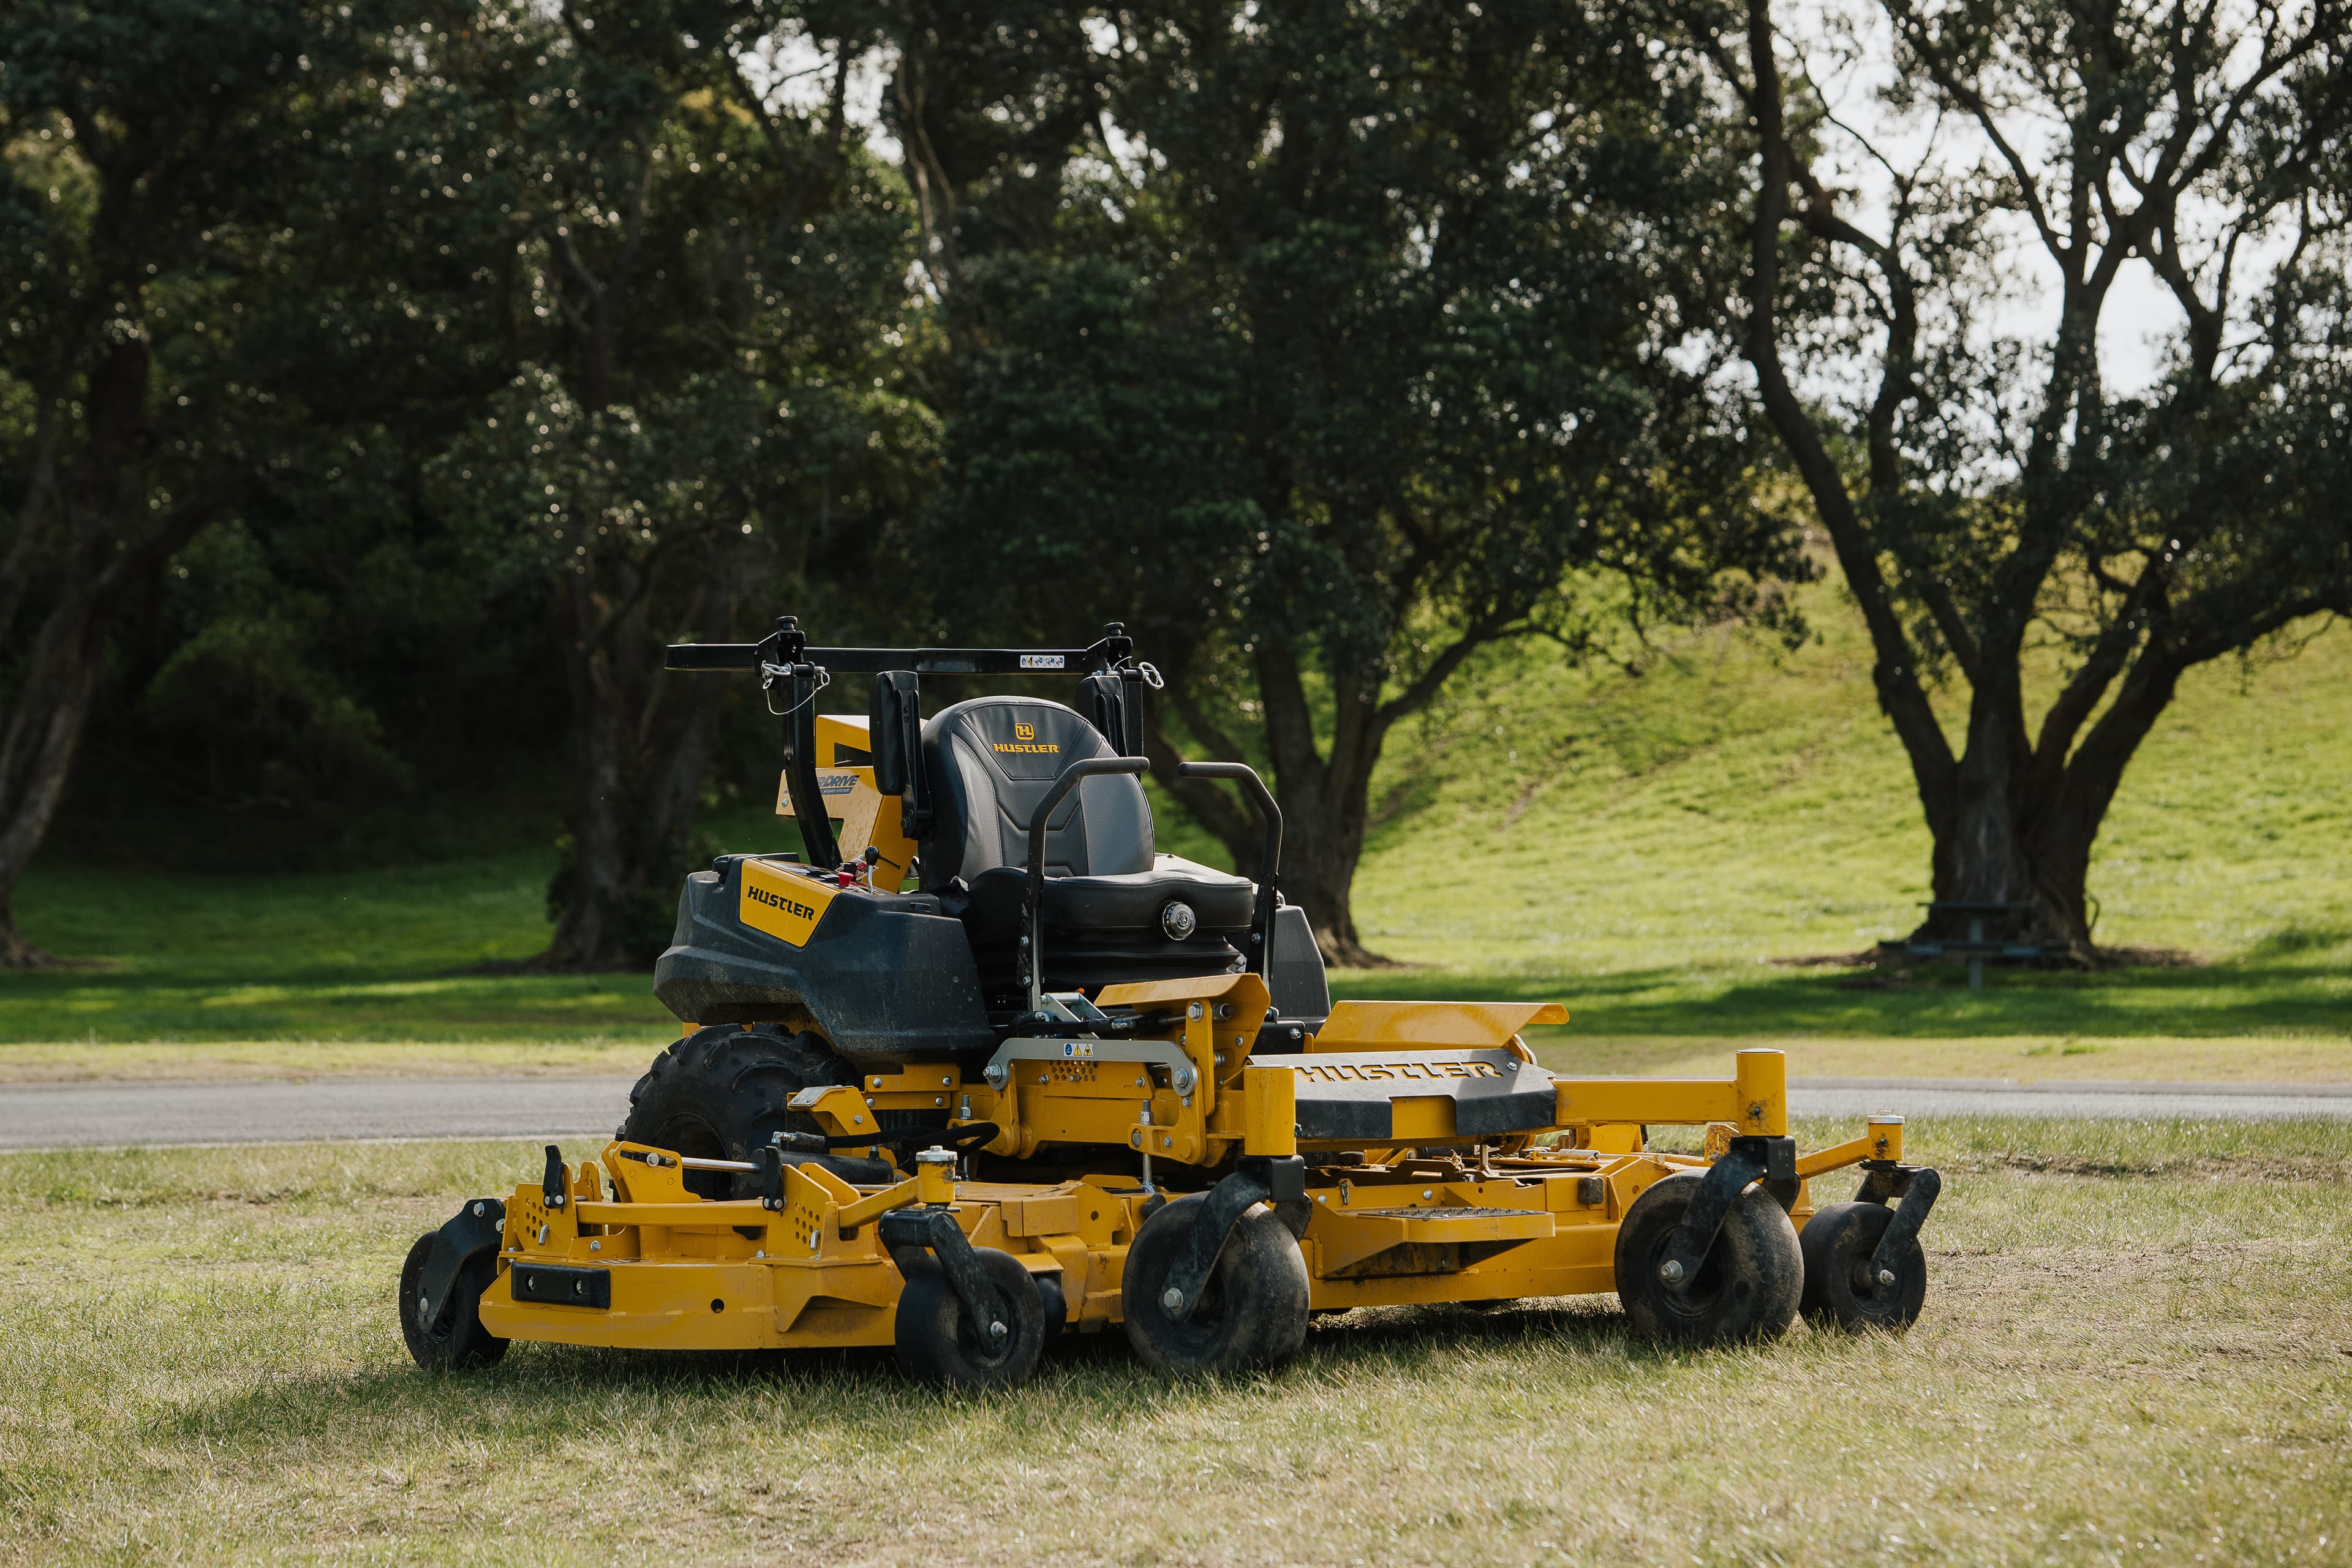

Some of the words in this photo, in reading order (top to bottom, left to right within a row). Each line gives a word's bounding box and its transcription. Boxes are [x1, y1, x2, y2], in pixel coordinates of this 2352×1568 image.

[993, 744, 1059, 753] HUSTLER
[818, 775, 860, 787] RDRIVE
[747, 886, 815, 921] HUSTLER
[1294, 1061, 1504, 1082] HUSTLER
